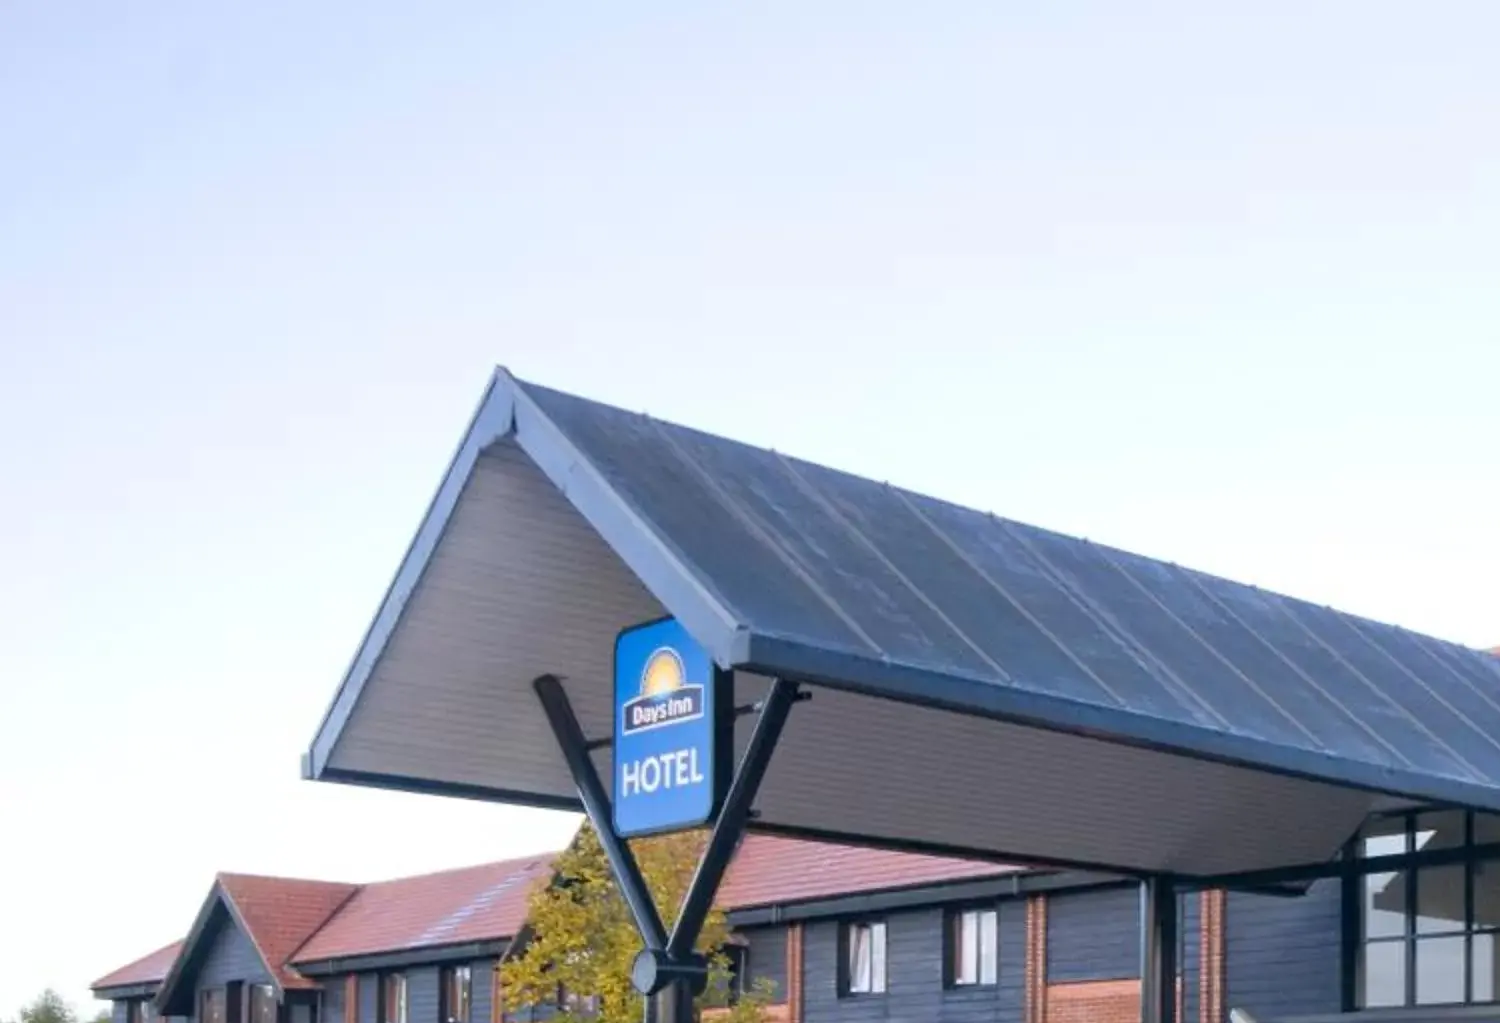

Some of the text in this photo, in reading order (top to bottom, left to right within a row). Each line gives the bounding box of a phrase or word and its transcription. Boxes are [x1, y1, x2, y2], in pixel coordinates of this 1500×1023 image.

[632, 697, 693, 725] Days Inn
[622, 747, 704, 797] HOTEL
